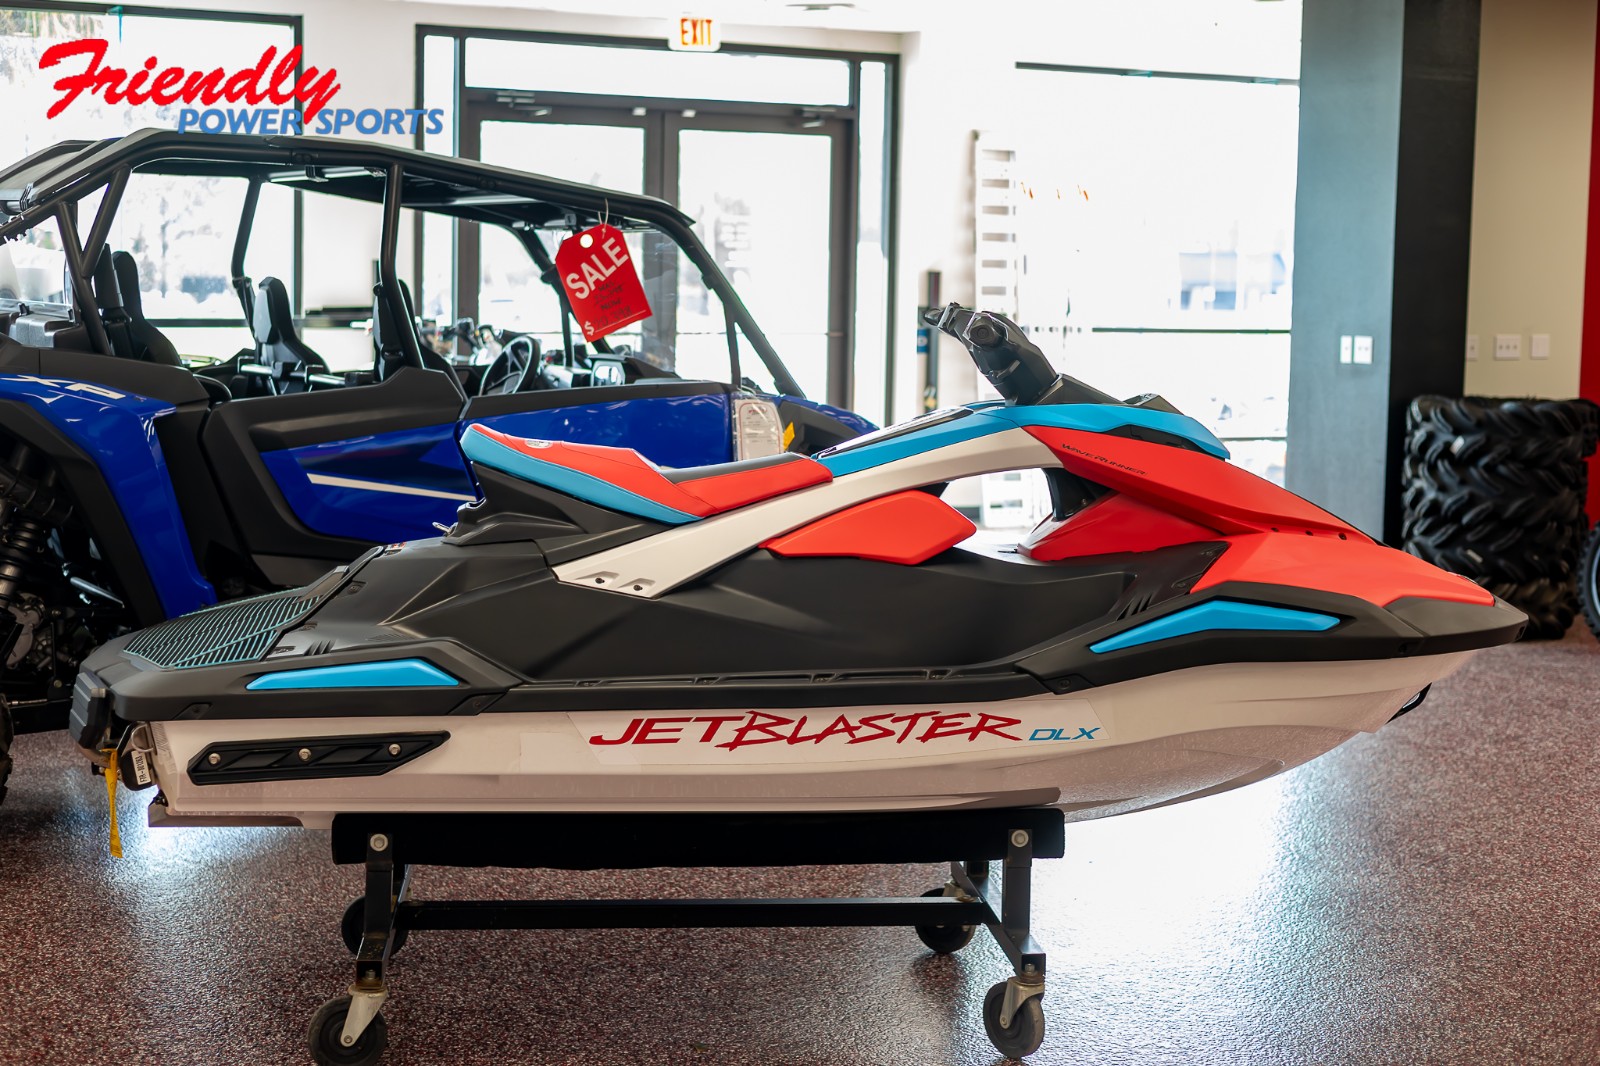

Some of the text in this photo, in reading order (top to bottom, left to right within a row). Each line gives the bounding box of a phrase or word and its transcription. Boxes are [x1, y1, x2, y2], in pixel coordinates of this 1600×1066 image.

[680, 18, 712, 46] EXIT
[566, 237, 629, 299] SALE
[1028, 727, 1101, 742] DLX
